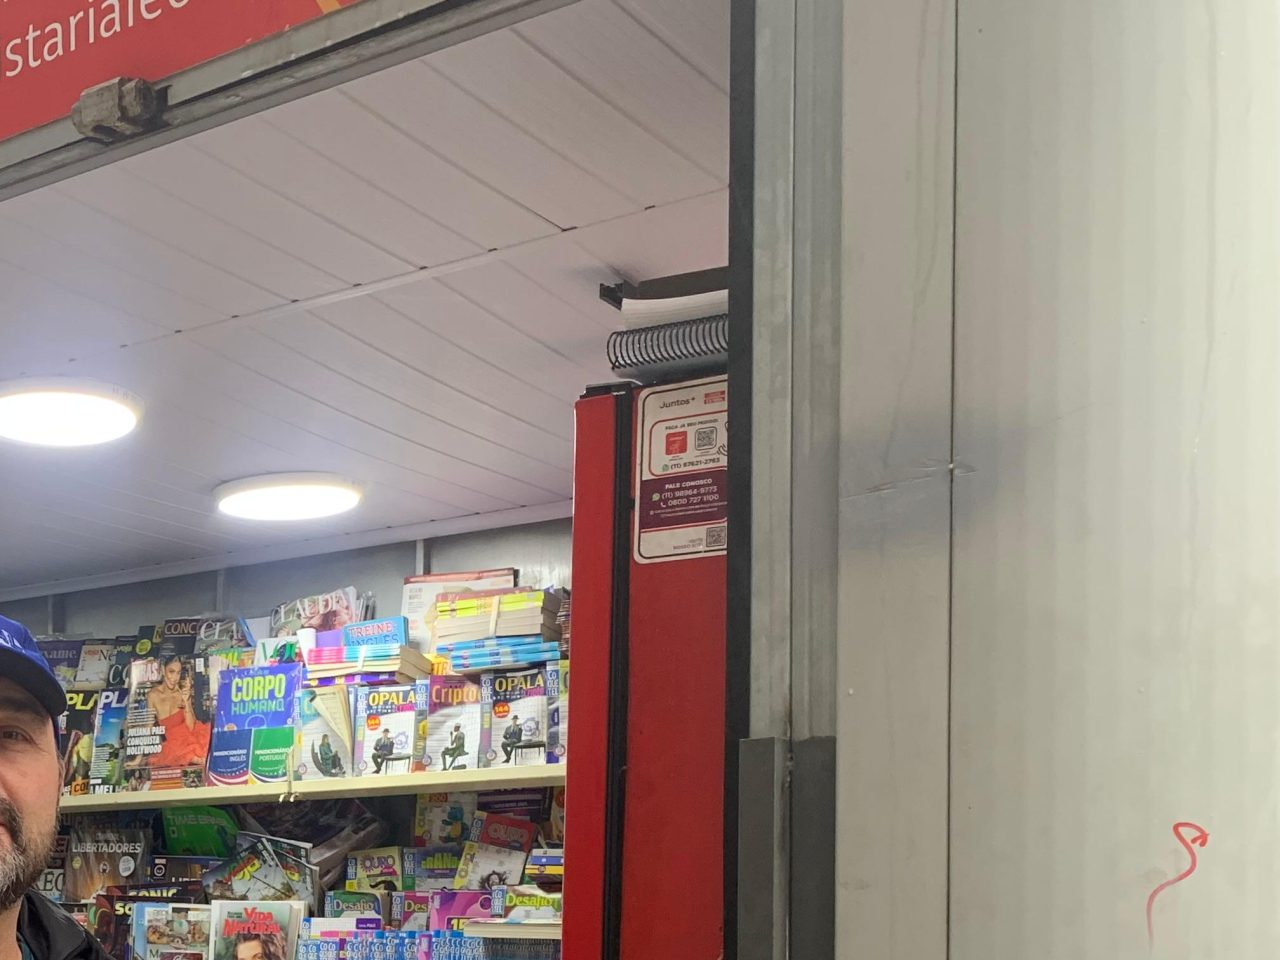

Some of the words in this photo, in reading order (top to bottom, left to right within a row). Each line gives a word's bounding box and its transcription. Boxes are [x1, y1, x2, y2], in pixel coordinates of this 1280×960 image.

[231, 673, 286, 702] CORPO
[494, 673, 544, 692] OPALA
[368, 690, 415, 706] OPALA
[71, 842, 143, 853] LIBERTADORES
